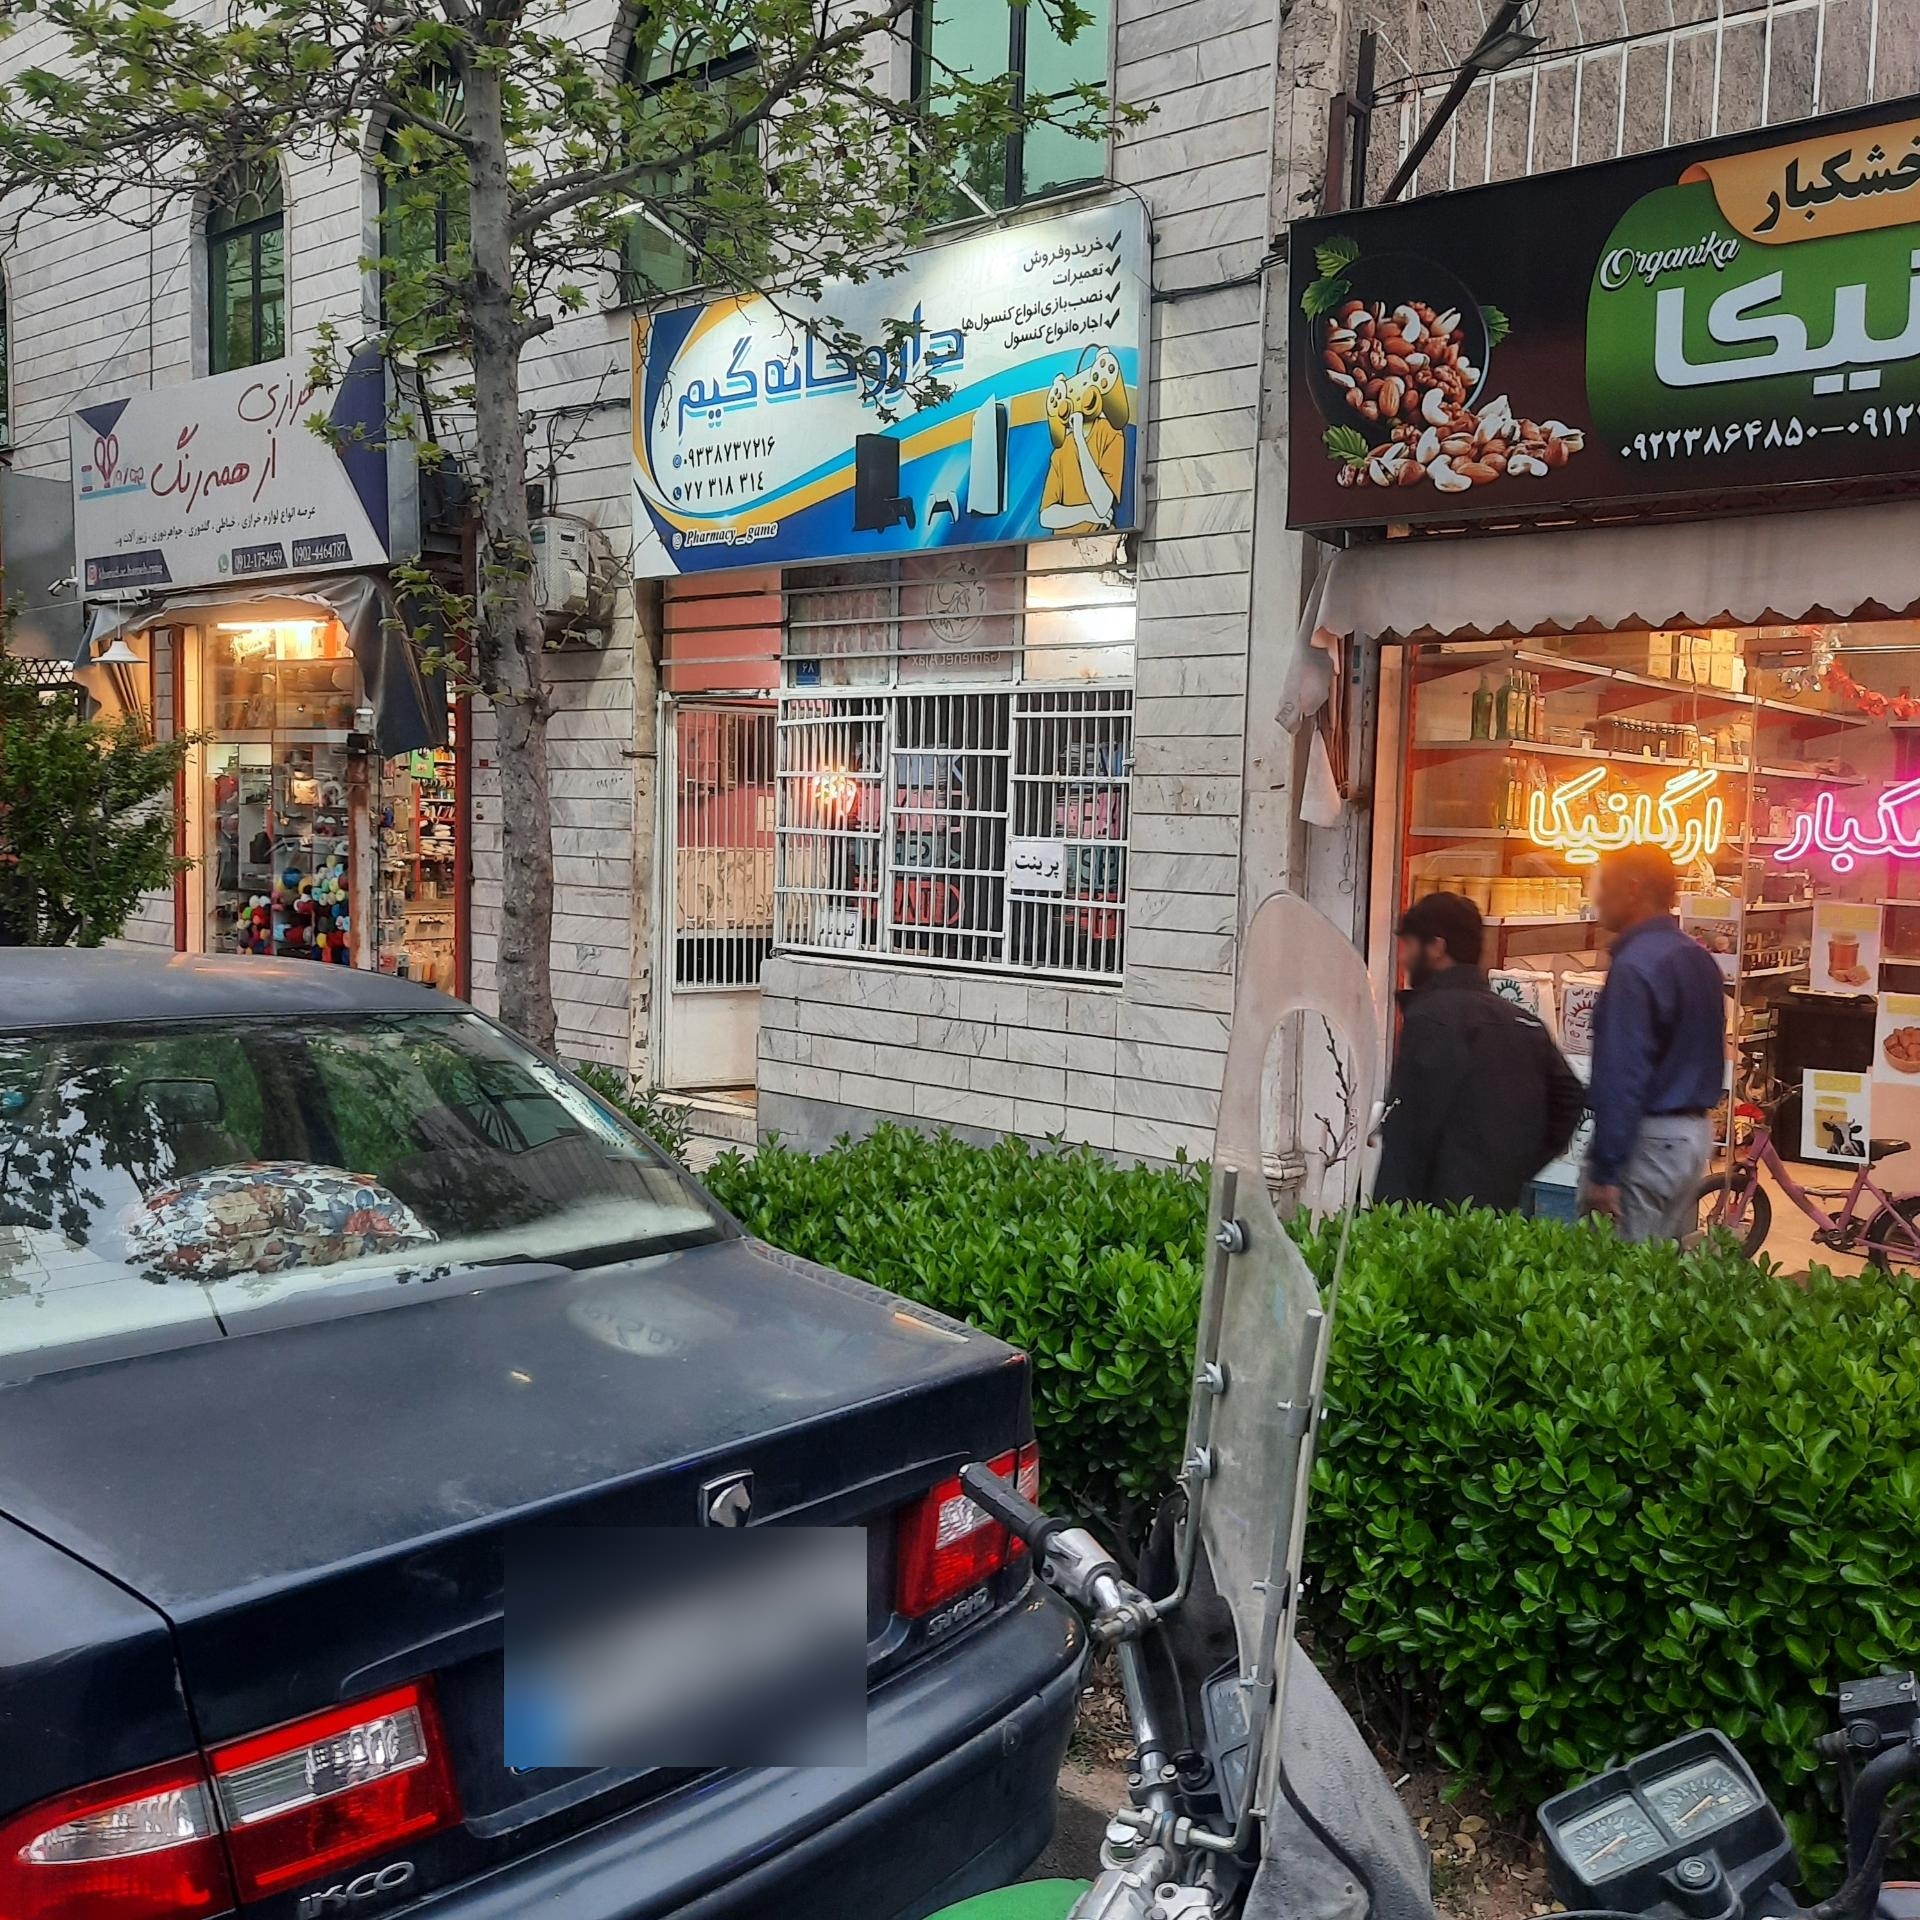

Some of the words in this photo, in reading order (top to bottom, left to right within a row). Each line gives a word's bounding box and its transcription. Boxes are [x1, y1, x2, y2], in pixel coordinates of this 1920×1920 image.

[1052, 263, 1103, 287] تعمیرات
[1599, 231, 1741, 289] Organika
[764, 299, 964, 404] داروخانه
[1004, 325, 1045, 350] کنسول
[678, 335, 758, 439] گیم
[253, 428, 276, 504] از
[684, 435, 776, 469] ۰۹۳۳۸۷۳۷۲۱۶
[150, 423, 203, 514] رنگ
[203, 462, 250, 497] همه
[263, 509, 279, 526] لوازم
[280, 506, 296, 523] انواع
[297, 505, 316, 519] عرضه
[234, 549, 283, 570] 0912-1754659
[294, 541, 346, 563] 0902-4464787
[802, 662, 815, 673] ۶۸
[1527, 766, 1724, 866] ارگانیکا
[1014, 852, 1060, 879] پرینت
